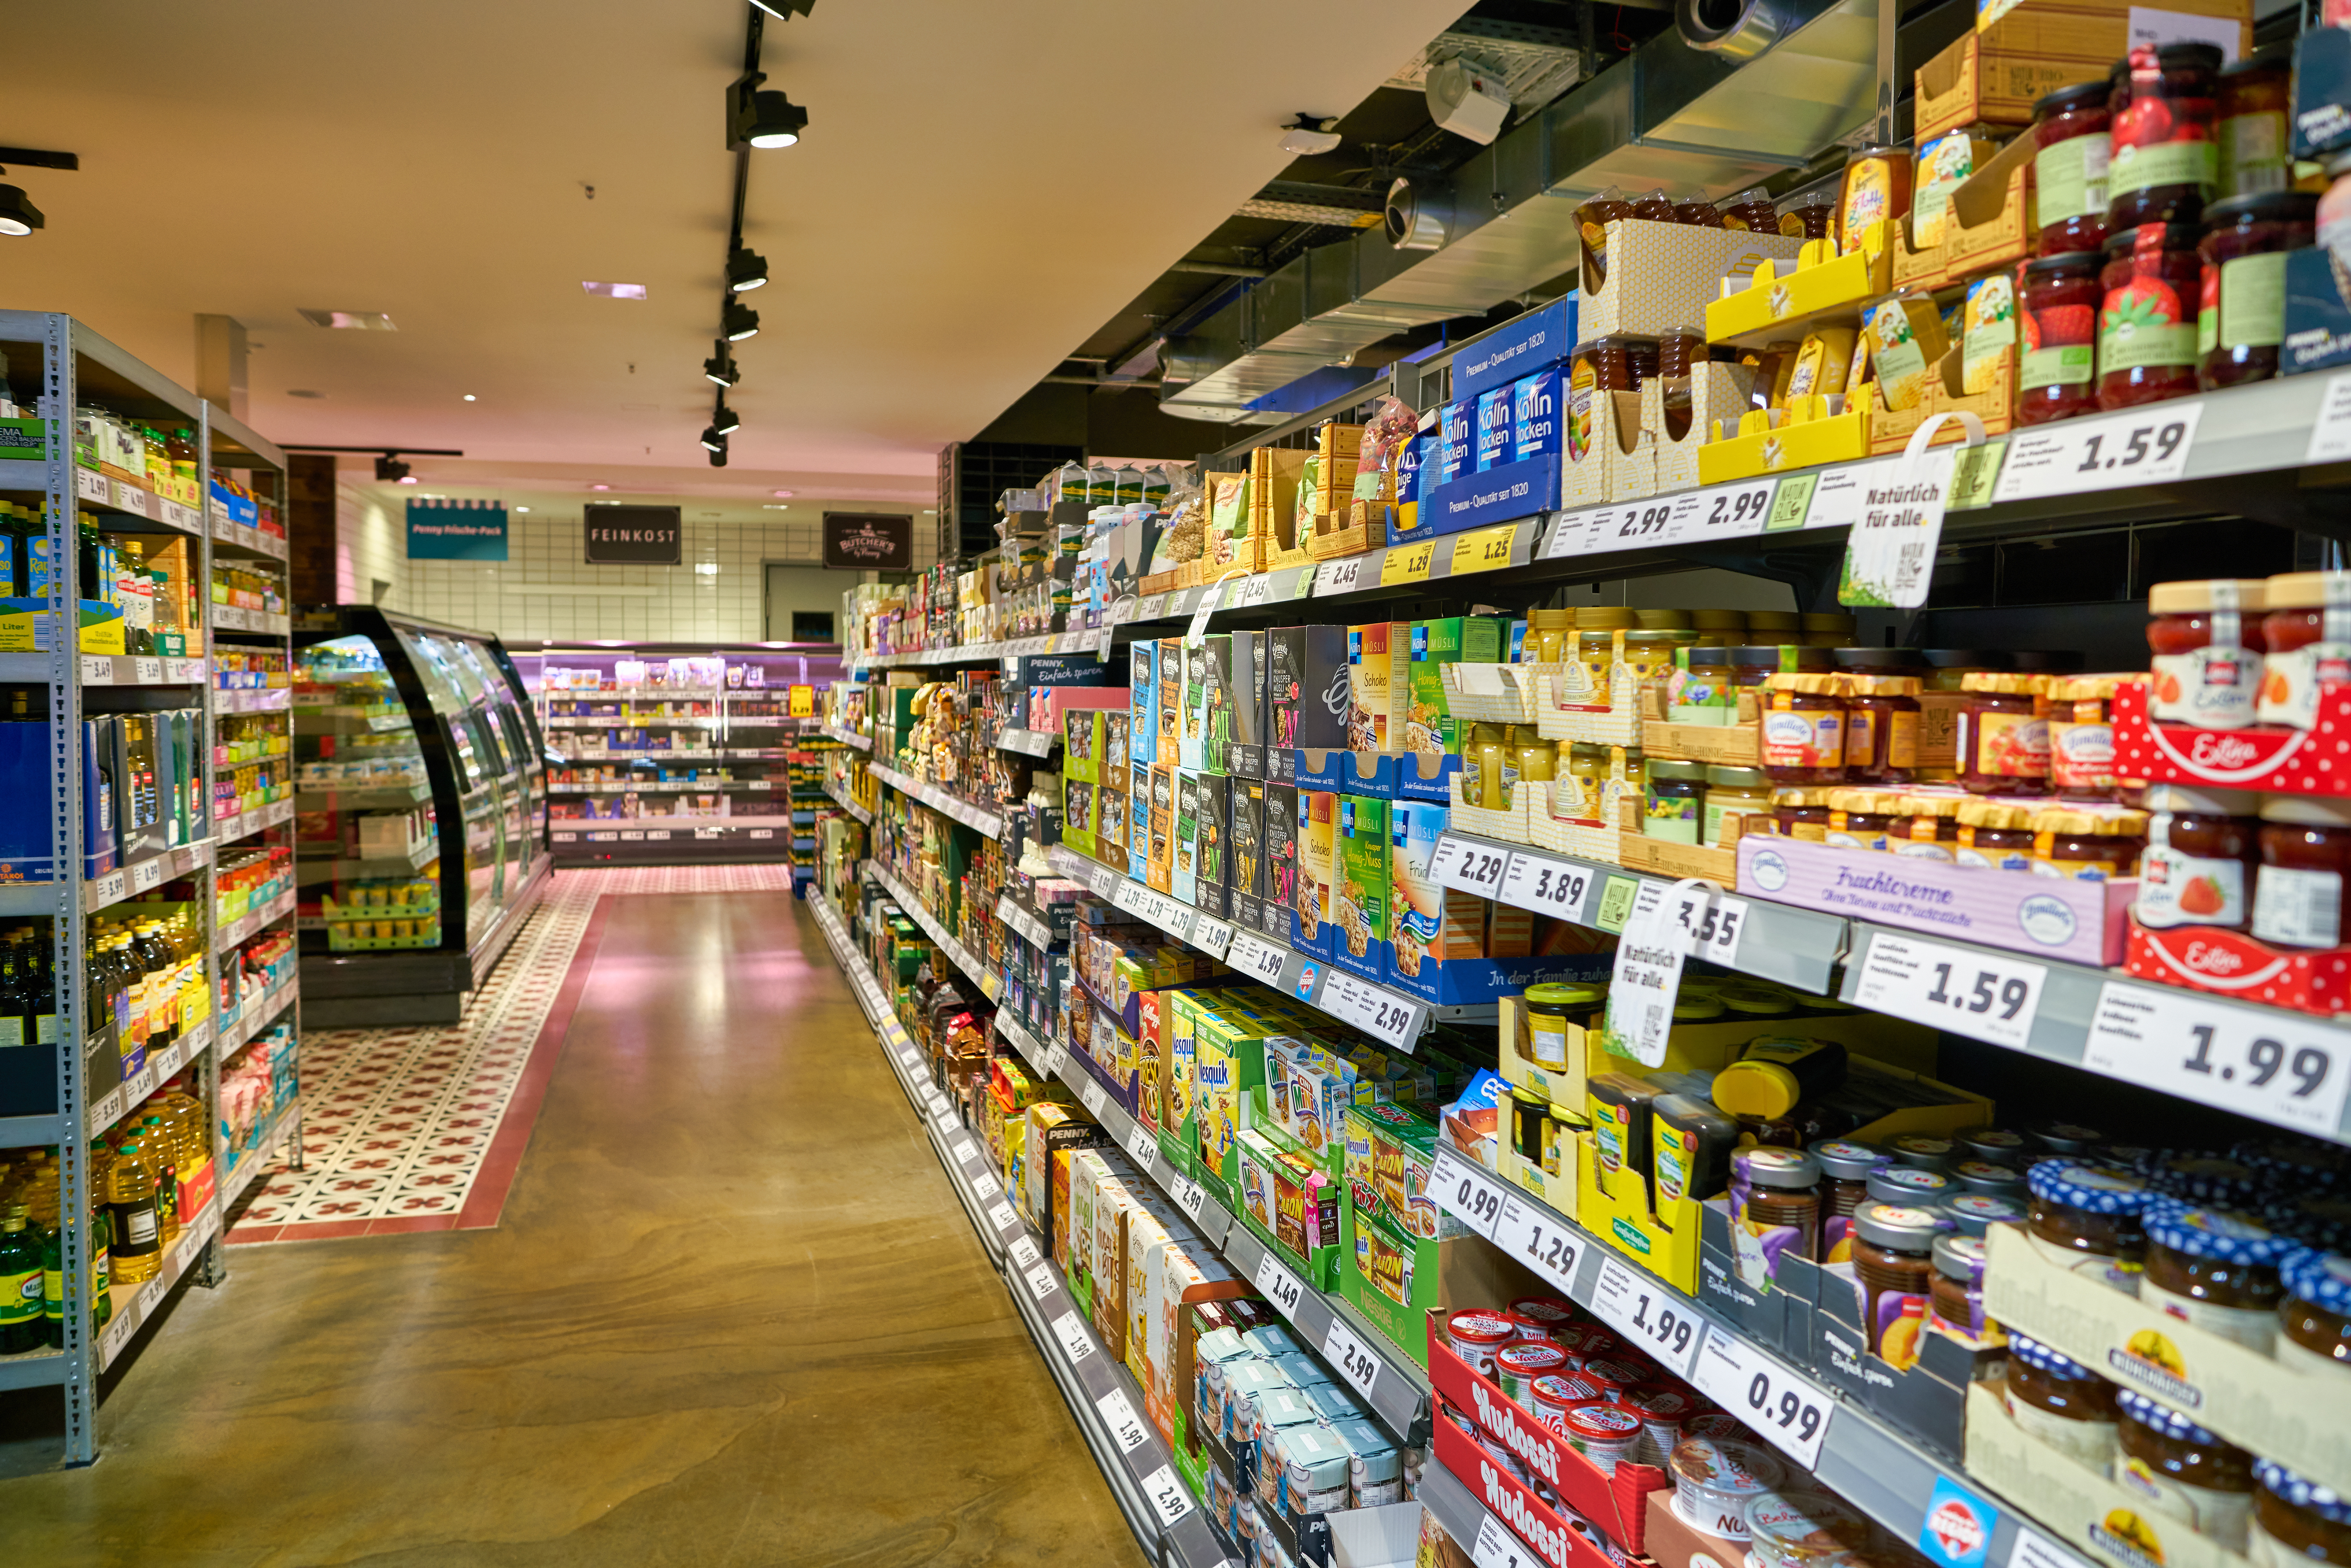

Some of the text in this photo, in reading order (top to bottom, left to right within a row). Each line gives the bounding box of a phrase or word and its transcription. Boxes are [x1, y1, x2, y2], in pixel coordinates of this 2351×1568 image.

[1529, 331, 1545, 348] 1820
[1515, 393, 1551, 420] Kölln
[2077, 423, 2186, 472] 1.59
[90, 478, 105, 496] 1.99
[1511, 482, 1529, 496] 1820
[1867, 484, 1938, 506] Natürlich
[1708, 490, 1768, 525] 2.99
[1619, 505, 1670, 537] 2.99
[1866, 508, 1928, 528] für alle.
[592, 528, 675, 542] FEINKOST
[839, 537, 896, 552] BUTCHER'S
[1485, 540, 1508, 559] 1.25
[1408, 556, 1428, 572] 1.29
[1333, 563, 1359, 585] 2.45
[1247, 581, 1265, 598] 2.45
[1200, 600, 1215, 608] Natürlich
[1272, 643, 1288, 656] Granola
[1350, 642, 1361, 652] Kölln
[1364, 641, 1384, 652] MÜSLI
[1412, 638, 1426, 650] Kölln
[1431, 637, 1455, 649] MÜSLI
[95, 662, 110, 677] 3.49
[1031, 659, 1064, 668] PENNY.
[1038, 667, 1103, 682] Einfach sparen
[1364, 673, 1387, 687] Schoko
[2191, 734, 2256, 767] Extra
[1299, 806, 1308, 817] Kölln
[1311, 810, 1327, 820] MÜSLI
[1343, 814, 1353, 825] Kölln
[1236, 822, 1250, 831] KNUSPER
[1357, 817, 1378, 829] MÜSLI
[1393, 821, 1406, 835] Kölln
[1270, 830, 1287, 839] KNUSPER
[1311, 839, 1329, 856] Schoko
[1365, 841, 1381, 851] Knusper
[1348, 848, 1381, 868] Honig-Nuss
[145, 865, 158, 882] 0.99
[1459, 852, 1503, 884] 2.29
[109, 878, 123, 896] 3.99
[1098, 875, 1110, 891] 0.99
[1536, 869, 1584, 906] 3.89
[1837, 865, 1954, 904] Fruchtcreme
[1125, 888, 1140, 907] 1.79
[1209, 895, 1220, 904] KNUSPER
[1147, 898, 1164, 918] 1.79
[1244, 906, 1258, 916] KNUSPER
[1171, 910, 1189, 930] 1.79
[1409, 914, 1423, 929] Ohne
[1207, 926, 1226, 948] 1.99
[1412, 930, 1425, 943] Vollkorn
[1258, 950, 1283, 976] 1.99
[1624, 944, 1676, 969] Natürlich
[2185, 941, 2242, 971] Extra
[1299, 976, 1314, 986] REGION
[1508, 968, 1578, 985] der Familie
[1622, 966, 1640, 983] für
[1118, 978, 1129, 992] CORNY
[1928, 963, 2028, 1020] 1.59
[1375, 1002, 1409, 1035] 2.99
[1100, 1022, 1112, 1042] CORNY
[1118, 1038, 1132, 1058] CORNY
[1311, 1051, 1324, 1062] Nesquik
[1288, 1065, 1297, 1076] Nestlé
[2184, 1025, 2330, 1099] 1.99
[138, 1072, 150, 1094] 1.49
[1198, 1058, 1228, 1091] Nesquik
[1298, 1074, 1311, 1090] CINI
[103, 1096, 119, 1121] 3.59
[1049, 1129, 1090, 1139] PENNY.
[1138, 1139, 1155, 1164] 2.49
[1294, 1143, 1323, 1168] Cerealien-Riegel
[1345, 1135, 1370, 1159] Nesquik
[1249, 1159, 1258, 1173] CINI
[1182, 1170, 1201, 1212] 2.99
[1387, 1180, 1403, 1193] CEREALS
[1458, 1179, 1498, 1223] 0.99
[1020, 1247, 1035, 1263] 0.99
[1279, 1243, 1308, 1271] Cerealien-Riegel
[1527, 1226, 1575, 1275] 1.29
[149, 1278, 162, 1302] 0.99
[1035, 1274, 1052, 1293] 2.49
[1273, 1274, 1298, 1309] 1.49
[1707, 1276, 1732, 1297] Einfach
[1361, 1287, 1394, 1328] Nestlé
[115, 1315, 128, 1345] 2.69
[1632, 1294, 1691, 1354] 1.99
[1070, 1336, 1089, 1356] 1.99
[1509, 1353, 1554, 1362] Naschi
[1343, 1351, 1374, 1385] 2.99
[1749, 1373, 1821, 1442] 0.99
[1578, 1412, 1627, 1430] Naschi
[1120, 1420, 1143, 1446] 1.99
[1472, 1380, 1561, 1485] Nudossi
[1157, 1485, 1186, 1516] 2.99
[1480, 1460, 1573, 1568] Nudossi
[1484, 1521, 1497, 1538] NUDOSSI
[1479, 1537, 1495, 1557] AUFSTRICH
